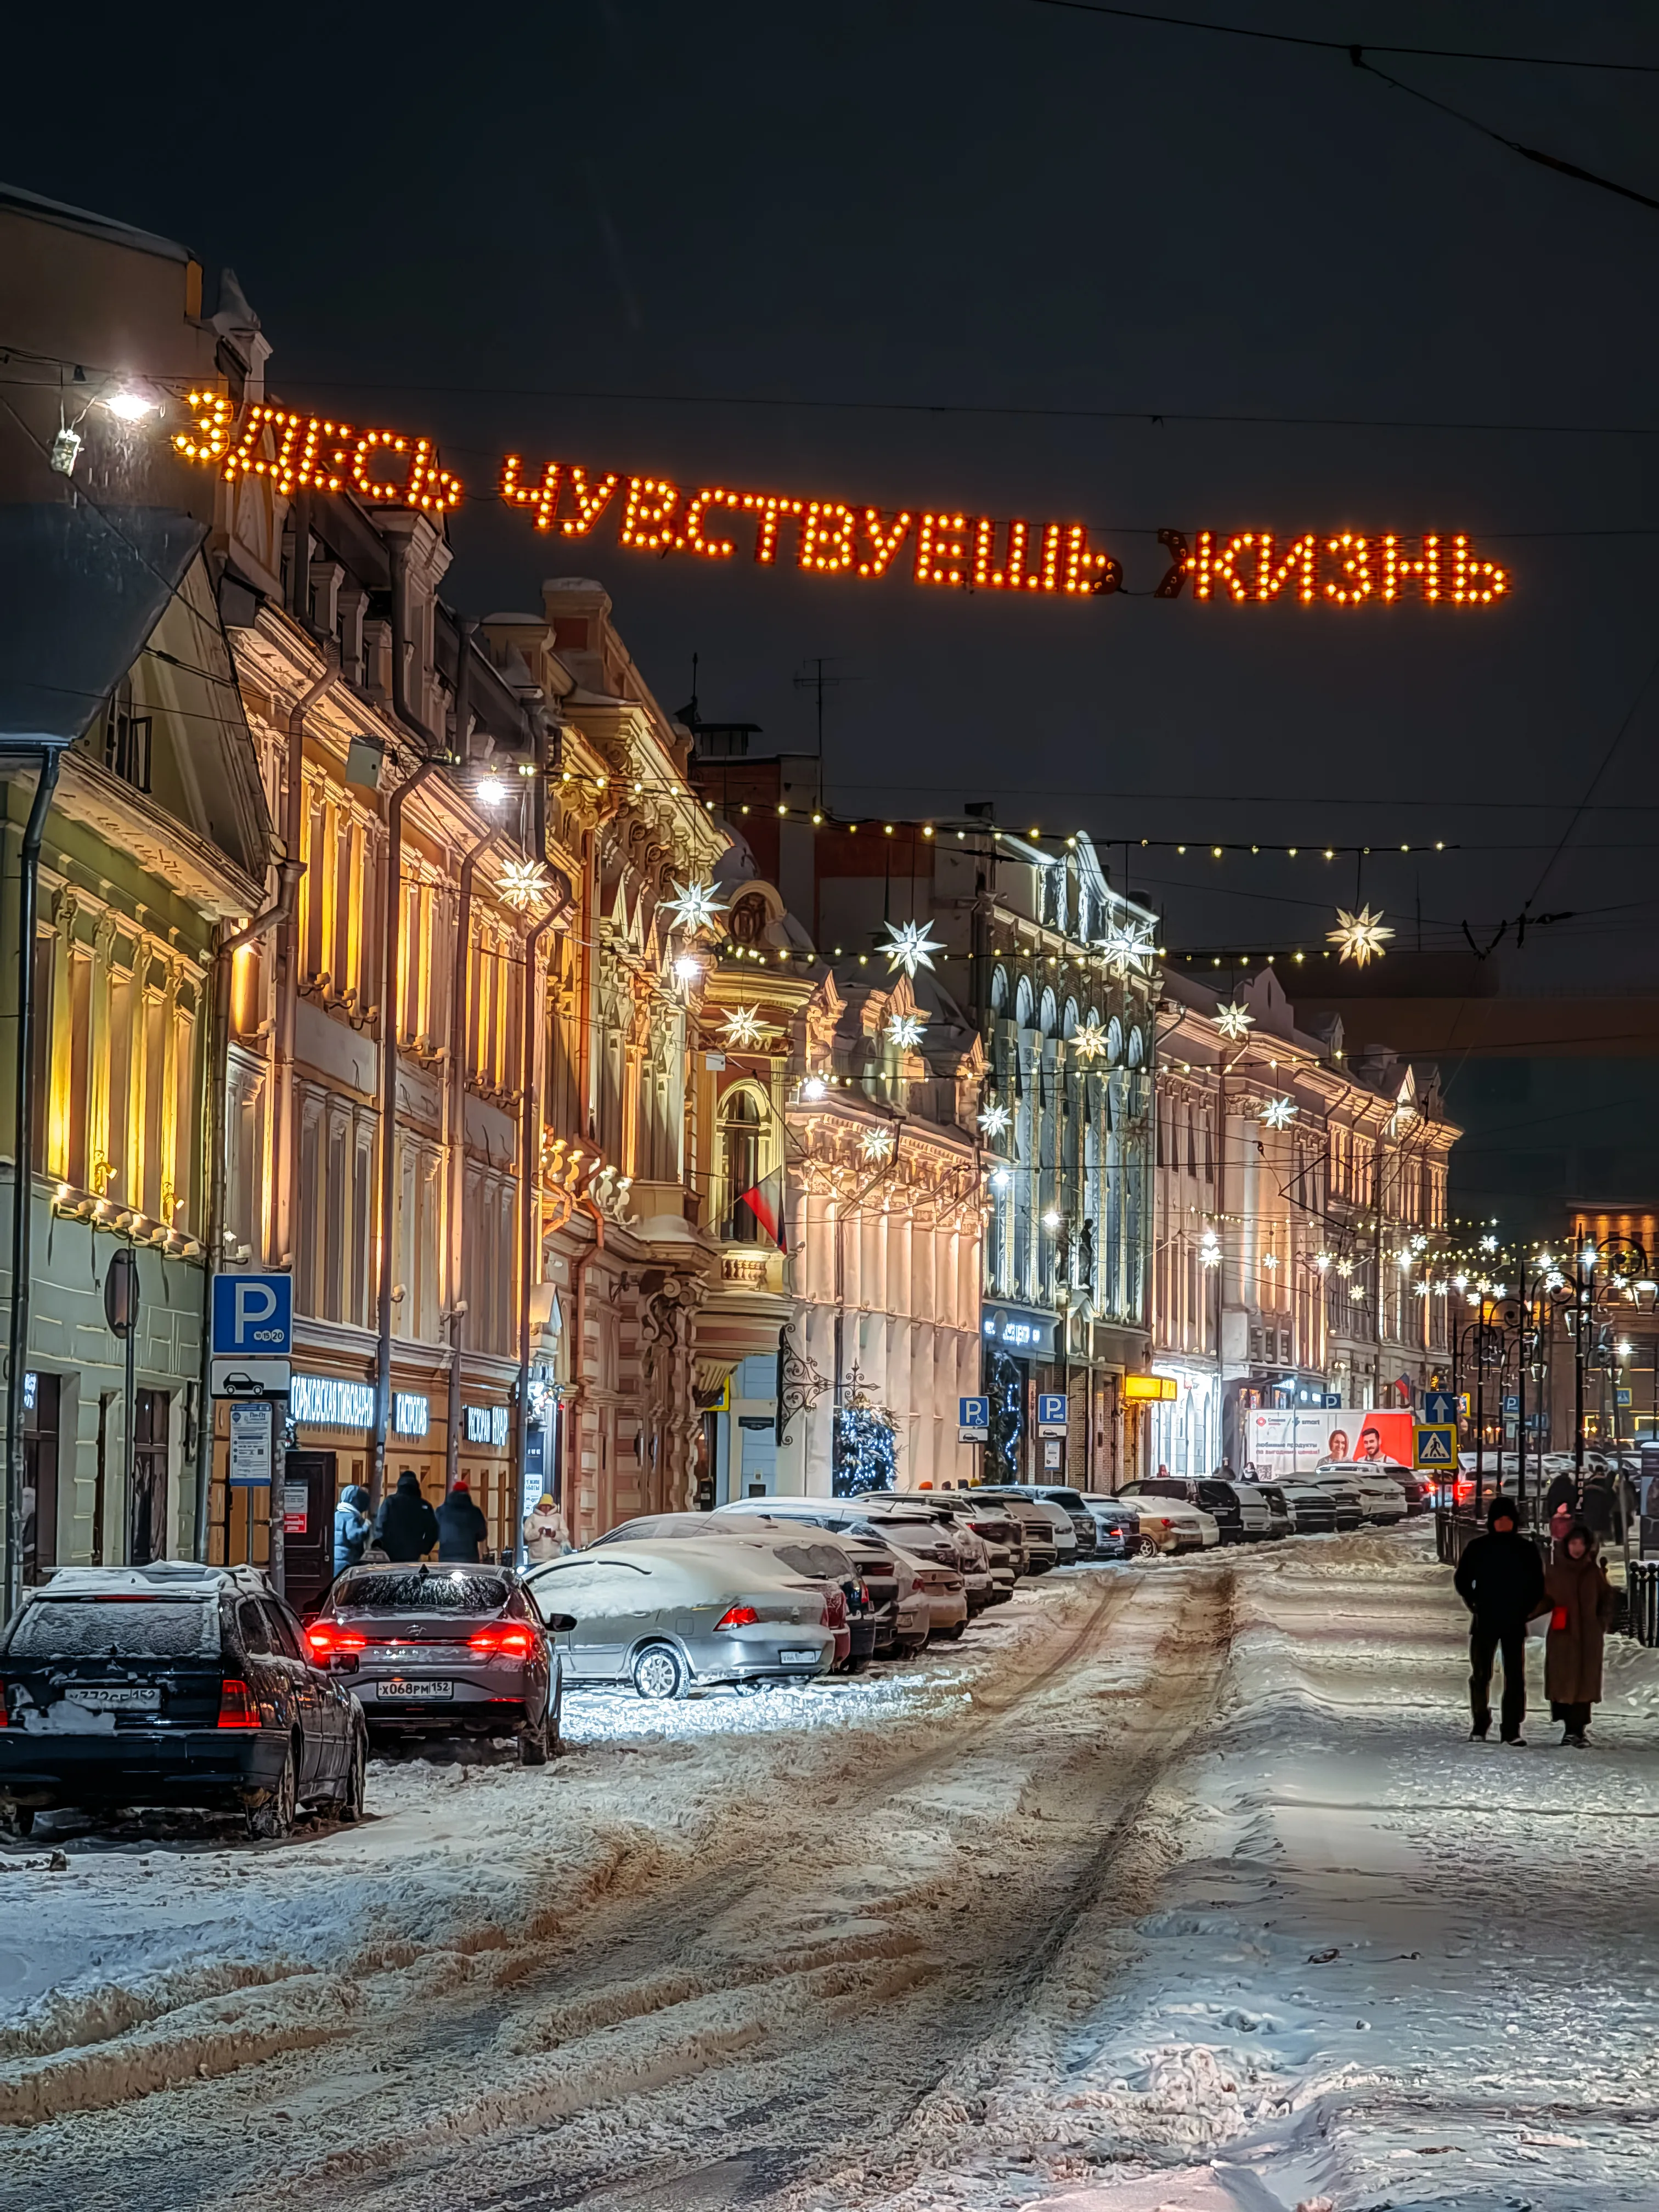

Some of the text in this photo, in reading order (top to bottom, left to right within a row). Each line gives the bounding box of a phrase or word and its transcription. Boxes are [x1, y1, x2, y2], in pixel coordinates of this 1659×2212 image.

[172, 393, 1510, 602] ЗДЕСЬ ЧУВСТВУЕШЬ ЖИЗНЬ
[235, 1283, 276, 1344] P
[493, 1406, 507, 1446] НУАР
[966, 1401, 981, 1423] P
[1046, 1397, 1062, 1419] P
